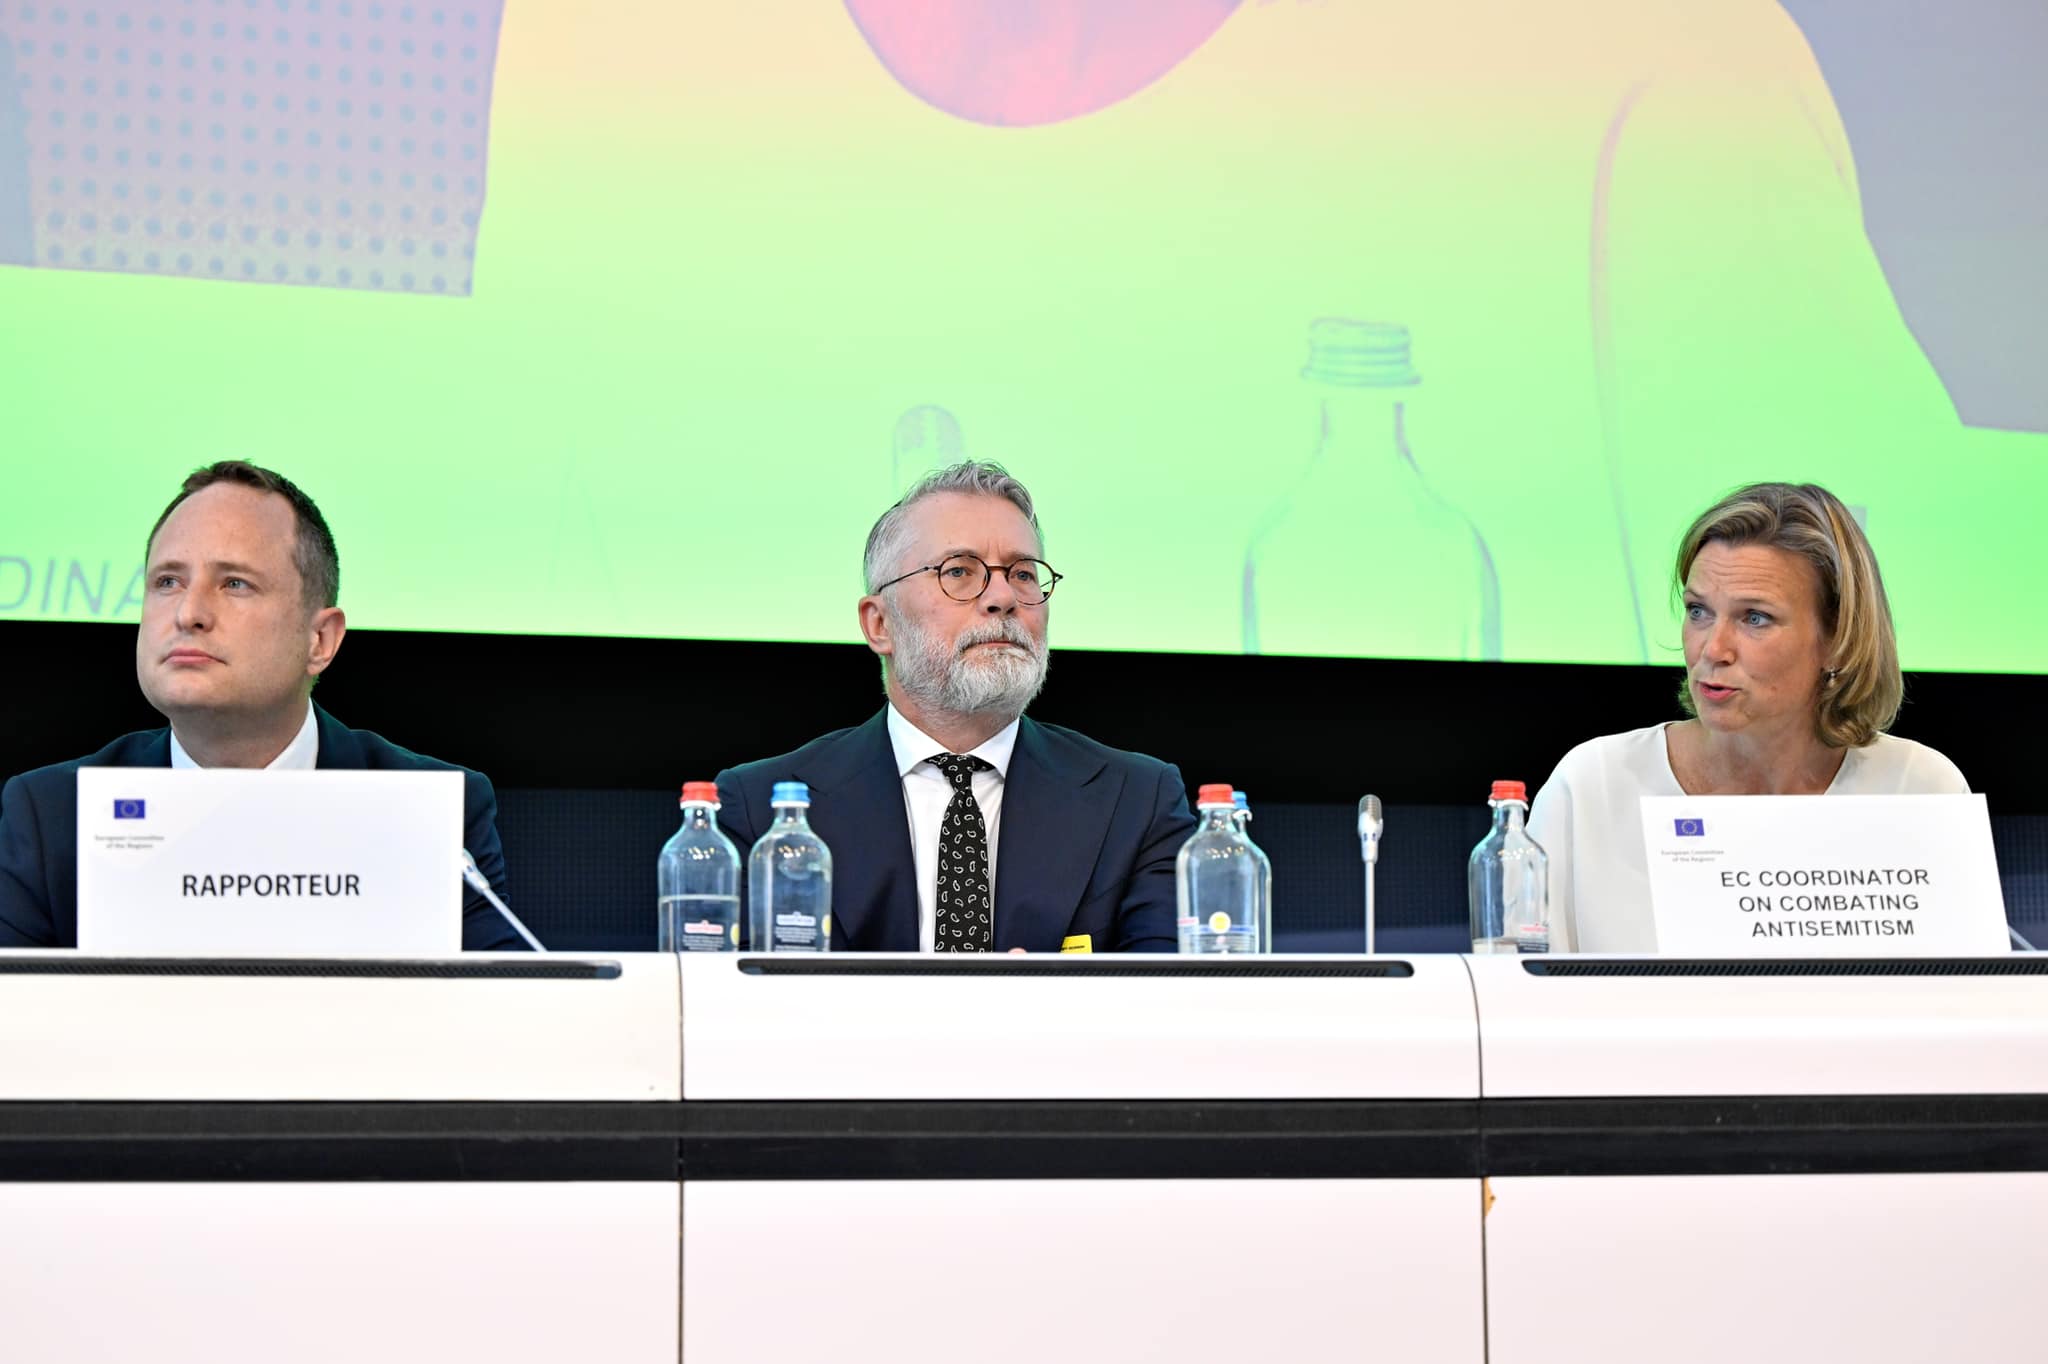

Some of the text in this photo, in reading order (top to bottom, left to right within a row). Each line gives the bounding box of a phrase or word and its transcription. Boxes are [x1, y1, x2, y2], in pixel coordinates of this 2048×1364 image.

[182, 873, 360, 897] RAPPORTEUR
[1720, 868, 1931, 888] EC COORDINATOR
[1738, 894, 1919, 913] ON COMBATING
[1752, 919, 1916, 937] ANTISEMITISM
